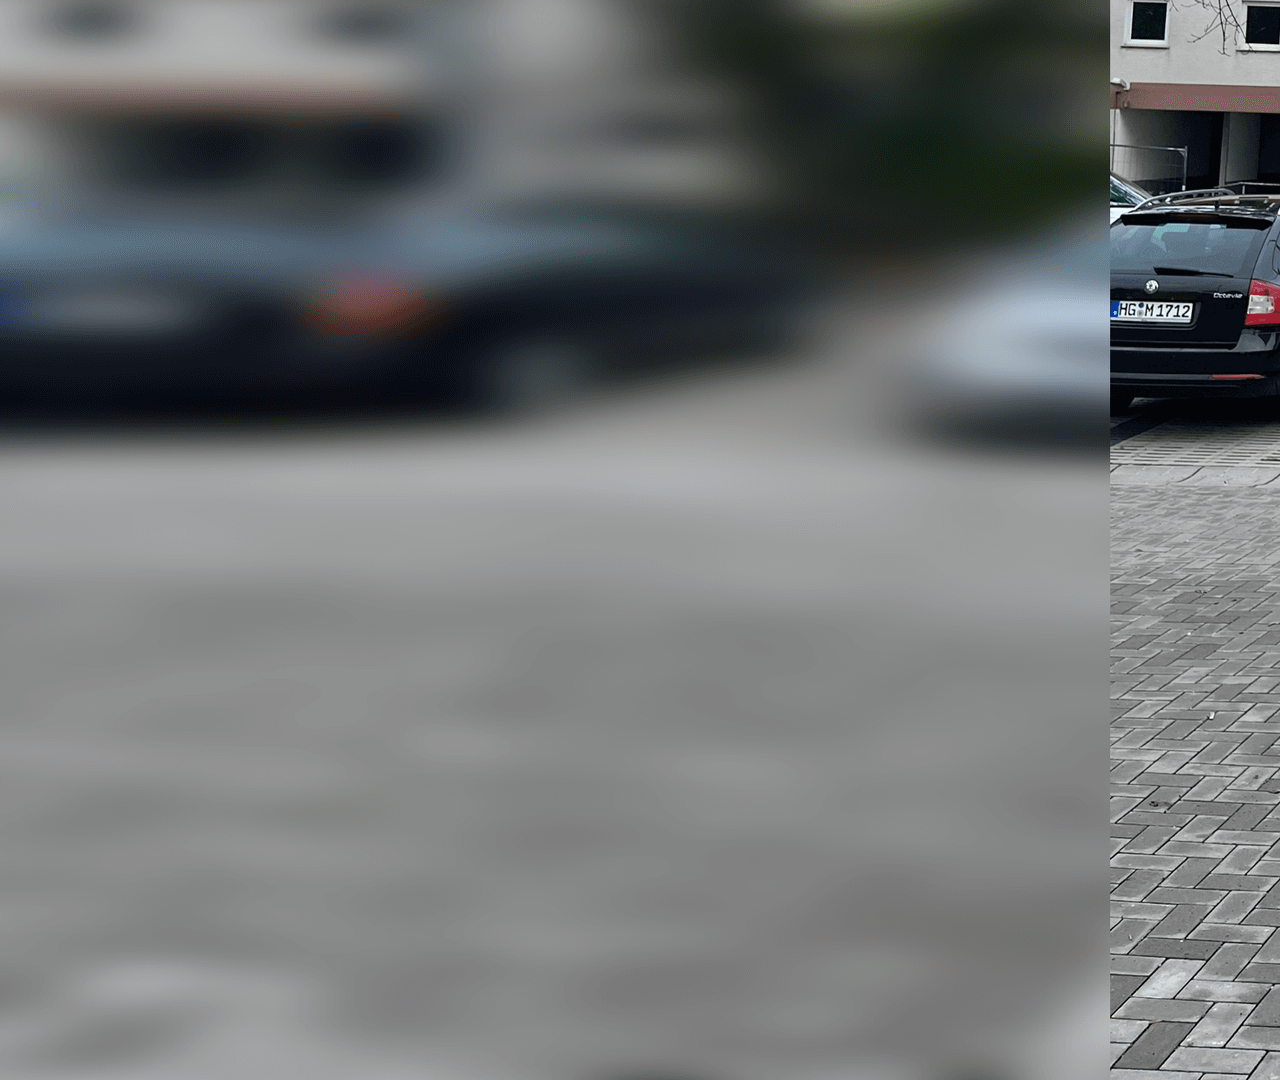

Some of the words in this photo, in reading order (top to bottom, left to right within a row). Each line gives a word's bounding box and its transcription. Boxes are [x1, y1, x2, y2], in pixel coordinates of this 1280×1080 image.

[1119, 303, 1136, 316] HG
[1144, 304, 1154, 317] M
[1156, 304, 1190, 318] 1712
